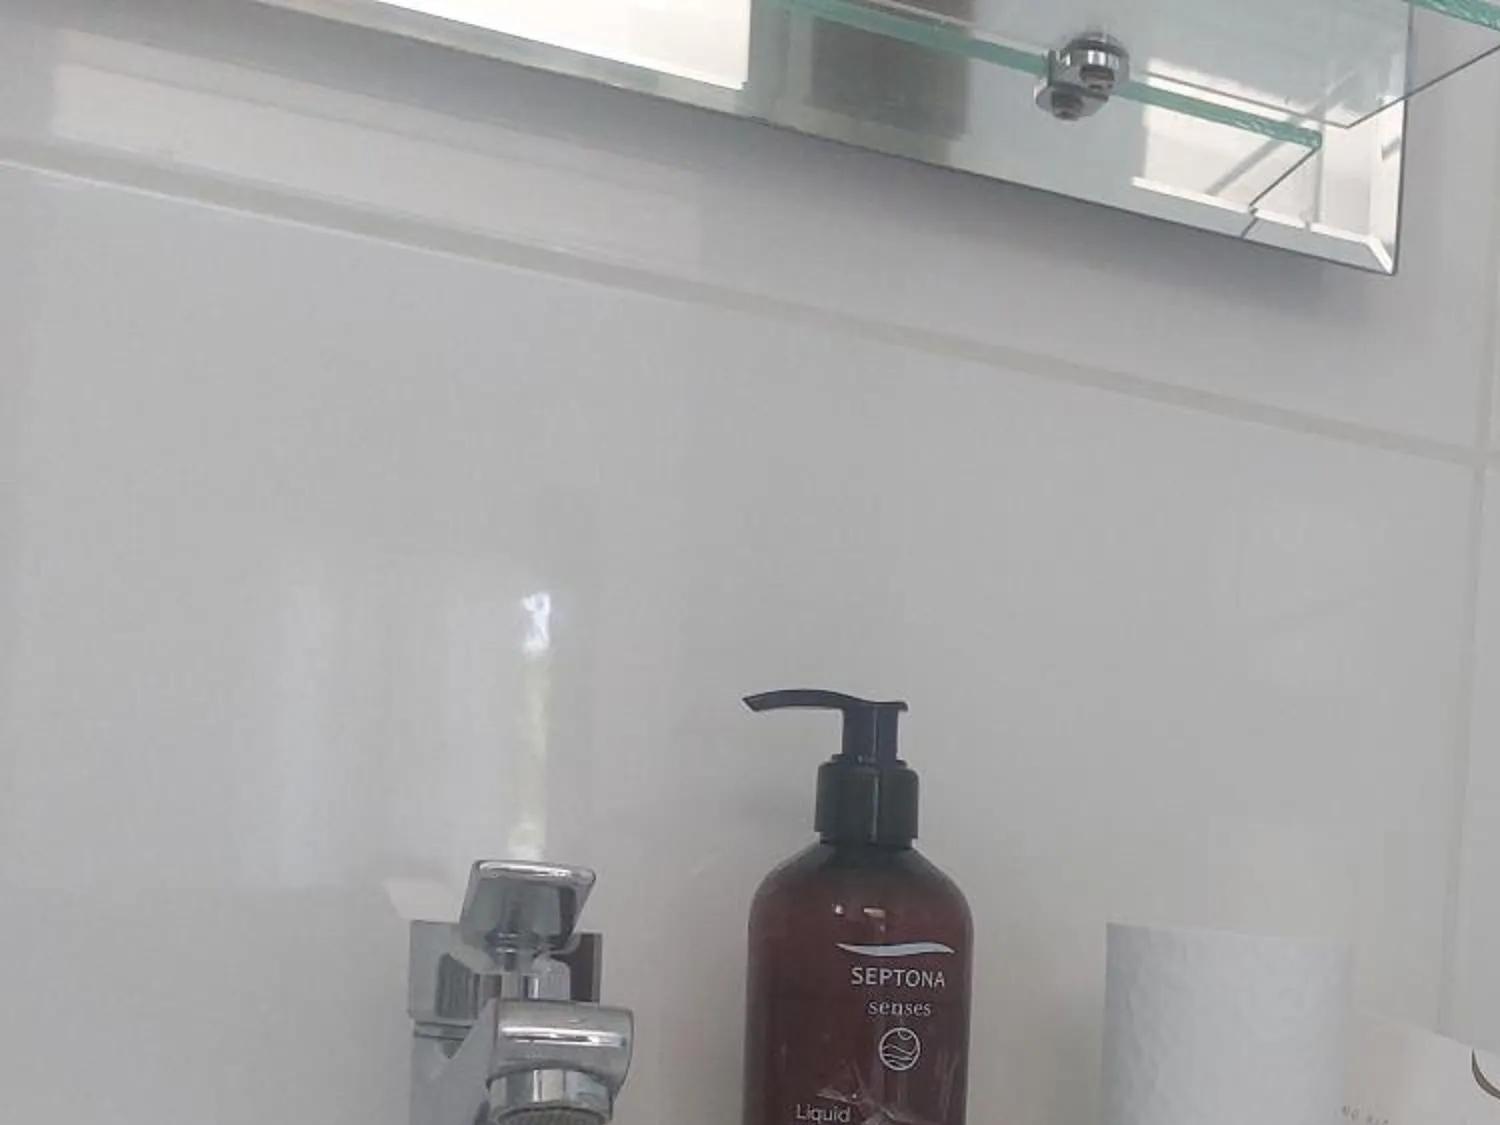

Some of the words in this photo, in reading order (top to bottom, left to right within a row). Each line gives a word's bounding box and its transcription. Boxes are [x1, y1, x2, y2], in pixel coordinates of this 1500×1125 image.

[851, 967, 945, 988] SEPTONA
[868, 1001, 932, 1016] senses
[796, 1104, 850, 1122] Liquid
